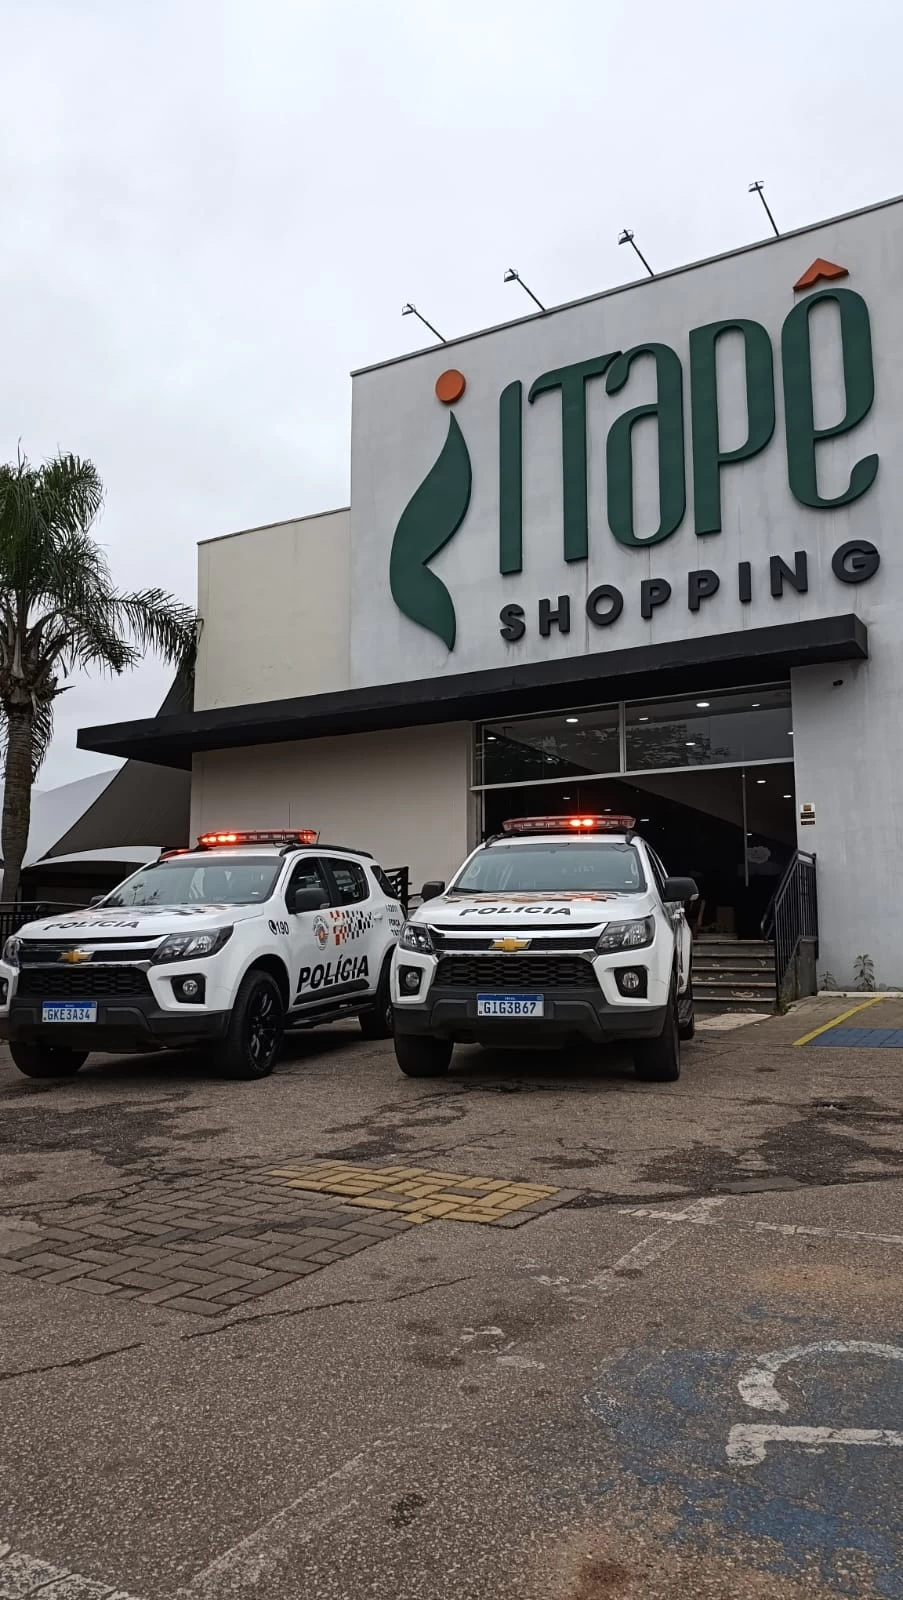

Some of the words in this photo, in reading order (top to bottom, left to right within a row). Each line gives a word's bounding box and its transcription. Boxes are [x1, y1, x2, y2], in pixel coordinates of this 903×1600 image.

[499, 539, 880, 641] SHOPPING
[276, 921, 290, 935] 190
[297, 954, 369, 994] POLÍCIA
[47, 1008, 90, 1021] GKE3A34
[484, 1001, 537, 1014] GIG3B67
